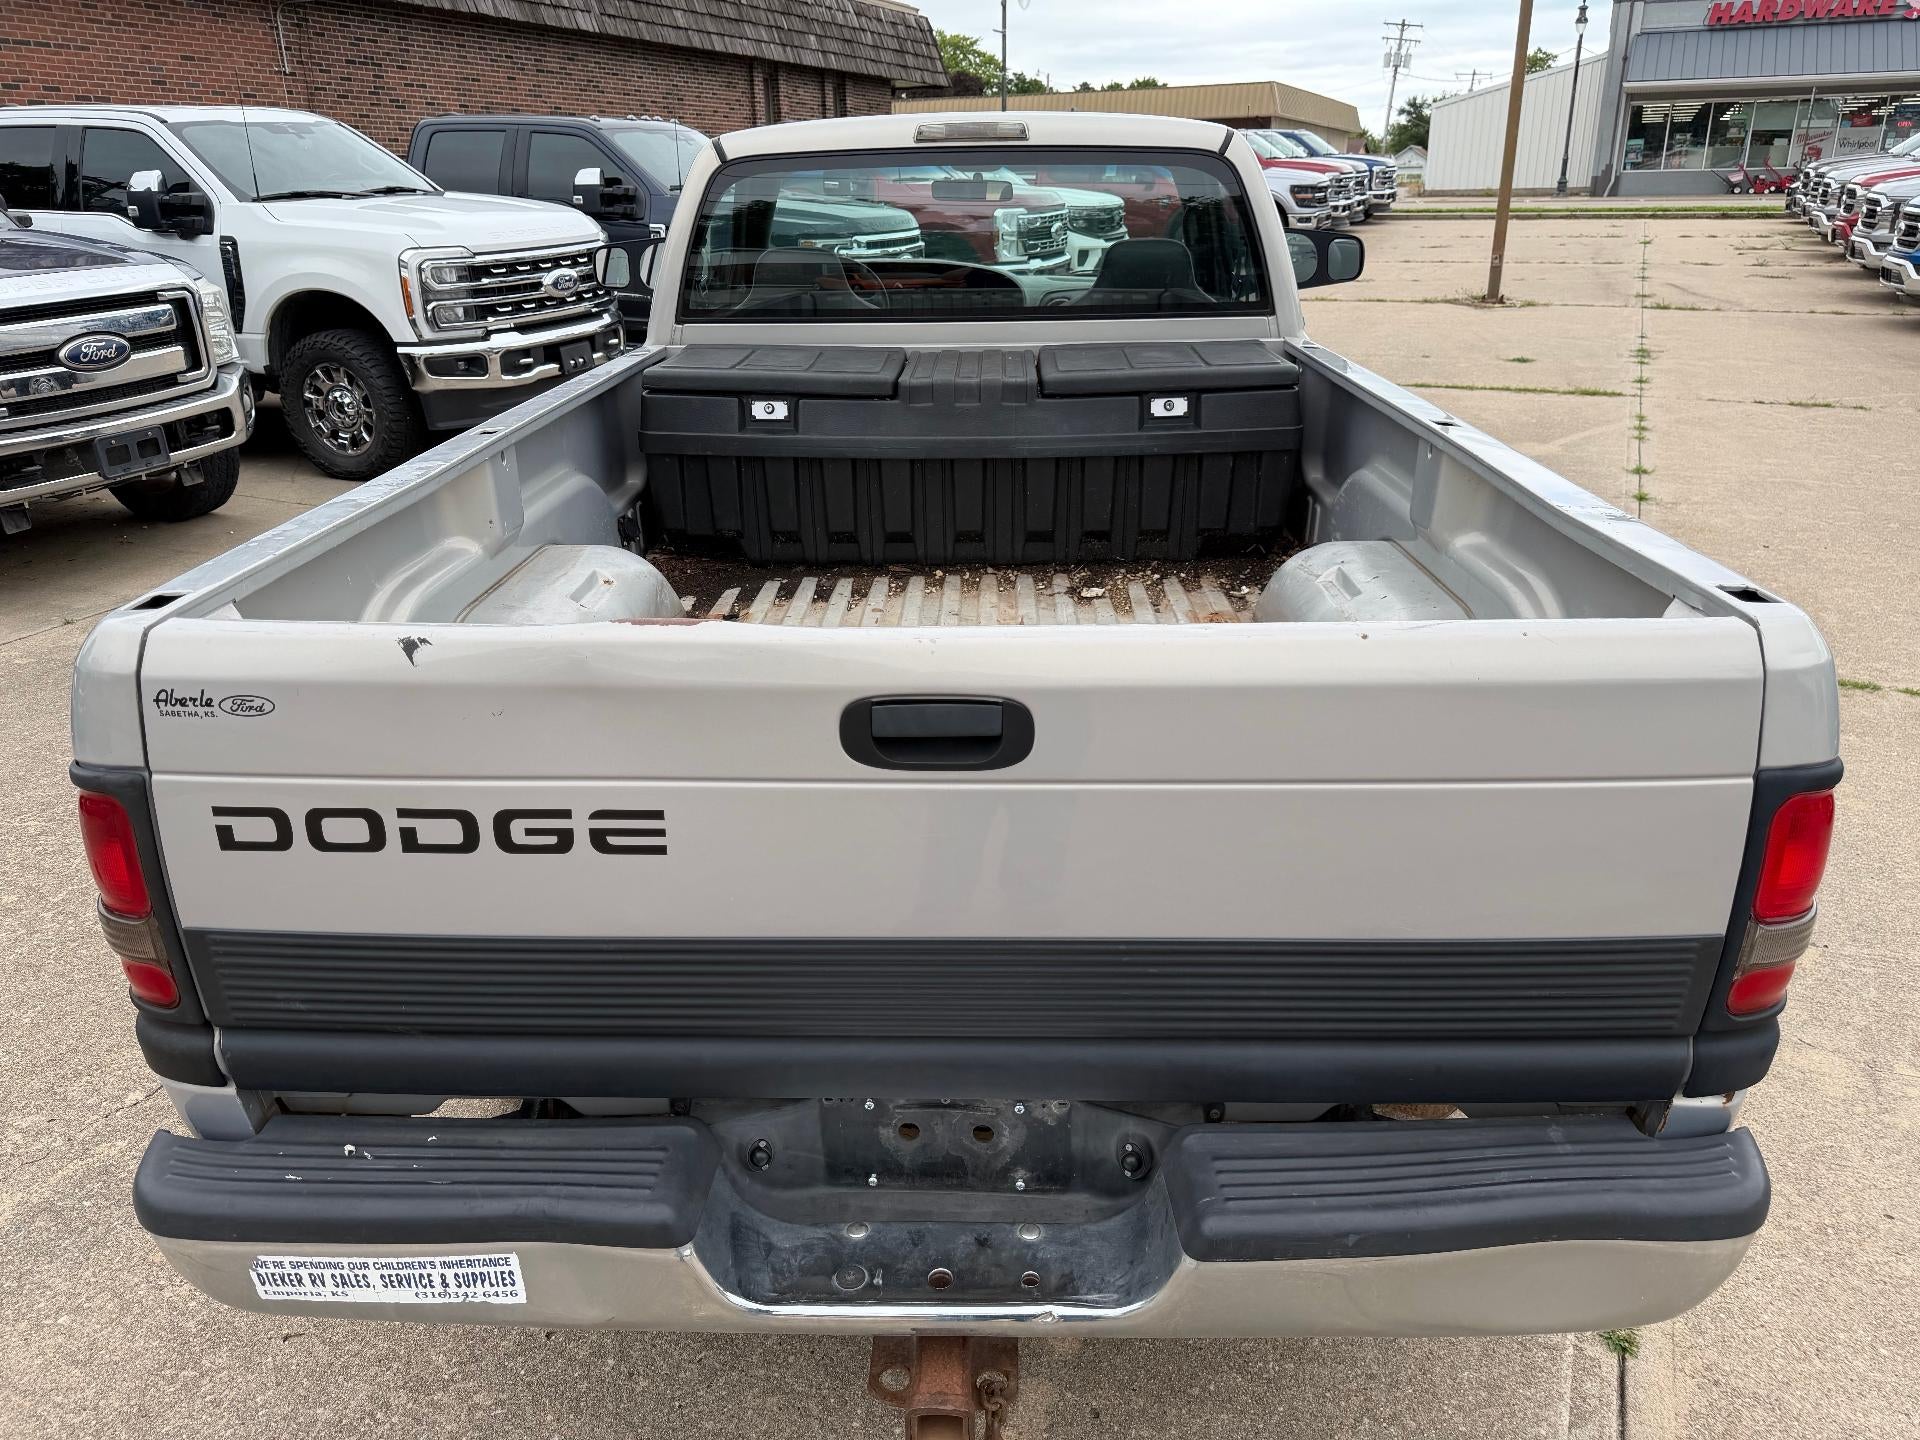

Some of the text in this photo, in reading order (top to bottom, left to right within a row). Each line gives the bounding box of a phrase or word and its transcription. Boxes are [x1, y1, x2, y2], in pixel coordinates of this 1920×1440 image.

[1708, 0, 1896, 25] HARDWARE
[1839, 139, 1877, 150] Whirlpool
[80, 342, 119, 362] Ford
[153, 688, 265, 713] Aberle Ford
[159, 710, 218, 719] SABETHA, KS.
[211, 805, 668, 856] DODGE
[252, 1256, 512, 1271] WE'RE SPENDING OUR CHILDREN'S INHERITANCE
[256, 1269, 517, 1290] DIEKER RV SALES, SERVICE & SUPPLIES
